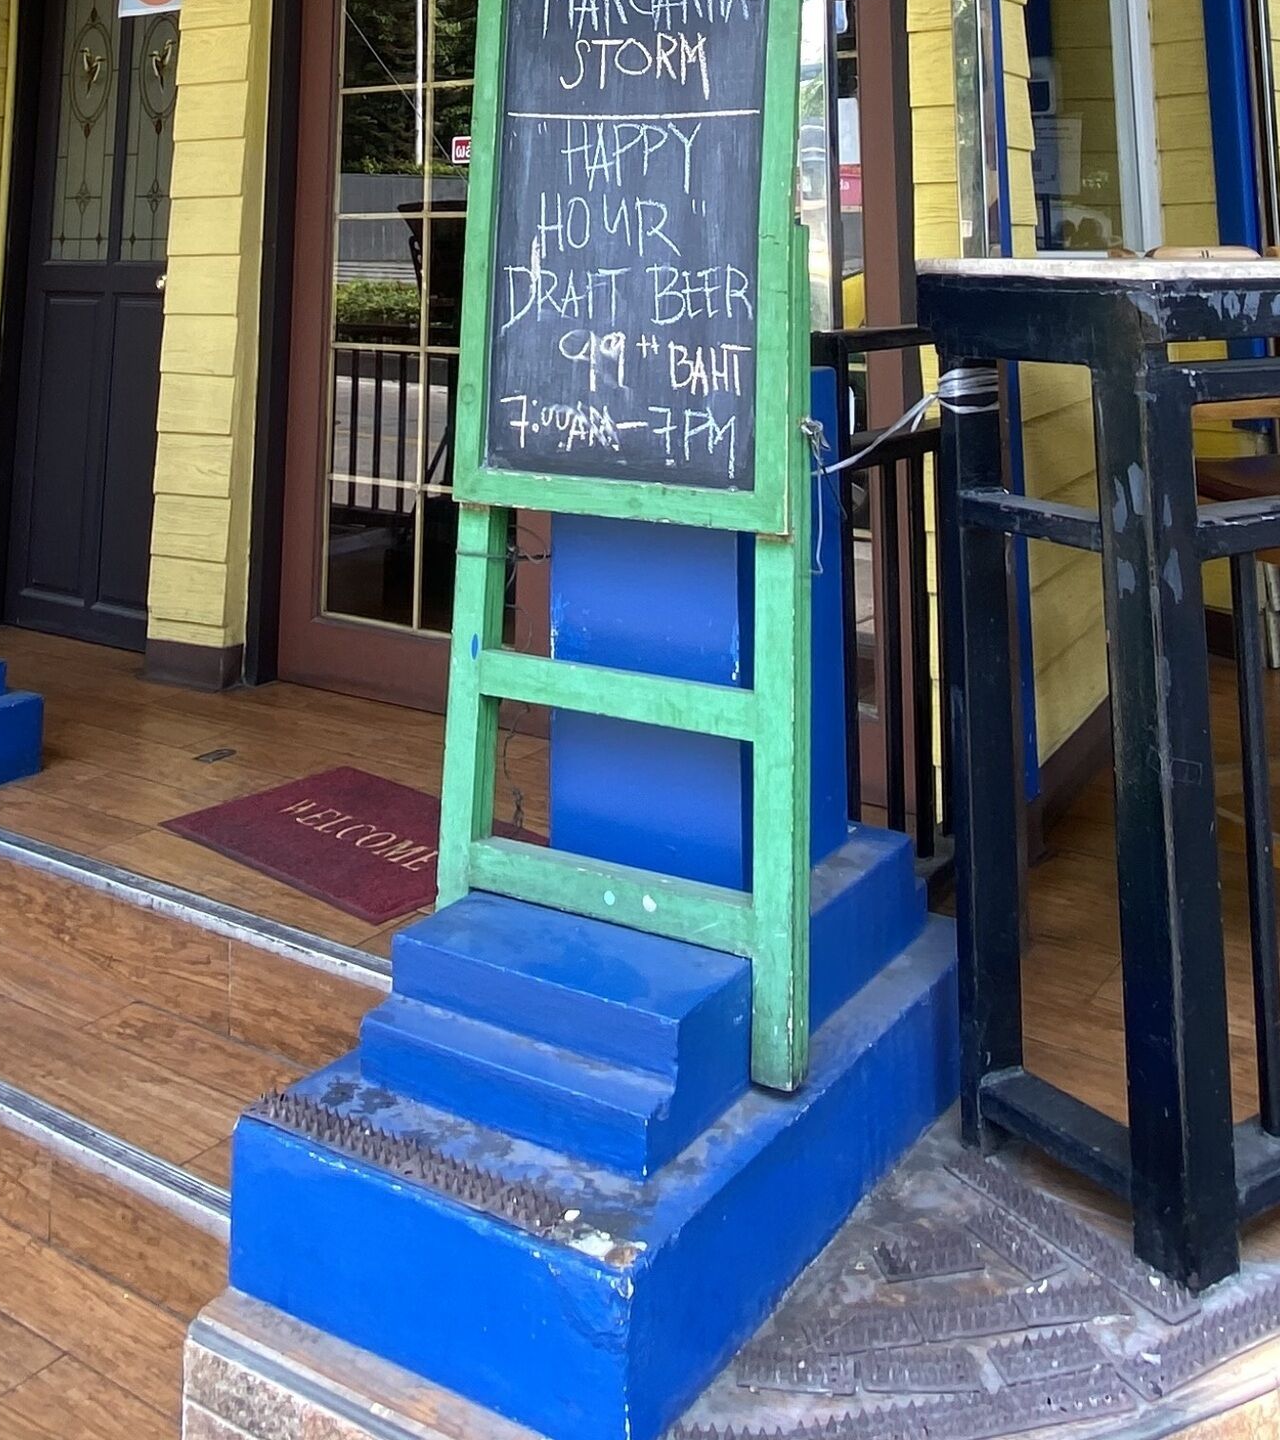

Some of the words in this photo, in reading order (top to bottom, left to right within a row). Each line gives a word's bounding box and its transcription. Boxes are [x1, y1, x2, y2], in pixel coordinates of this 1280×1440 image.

[559, 31, 711, 101] STORM
[500, 263, 631, 337] DRAFT
[646, 263, 753, 325] BEER
[668, 341, 752, 396] BAHT
[279, 798, 439, 871] WELCOME
